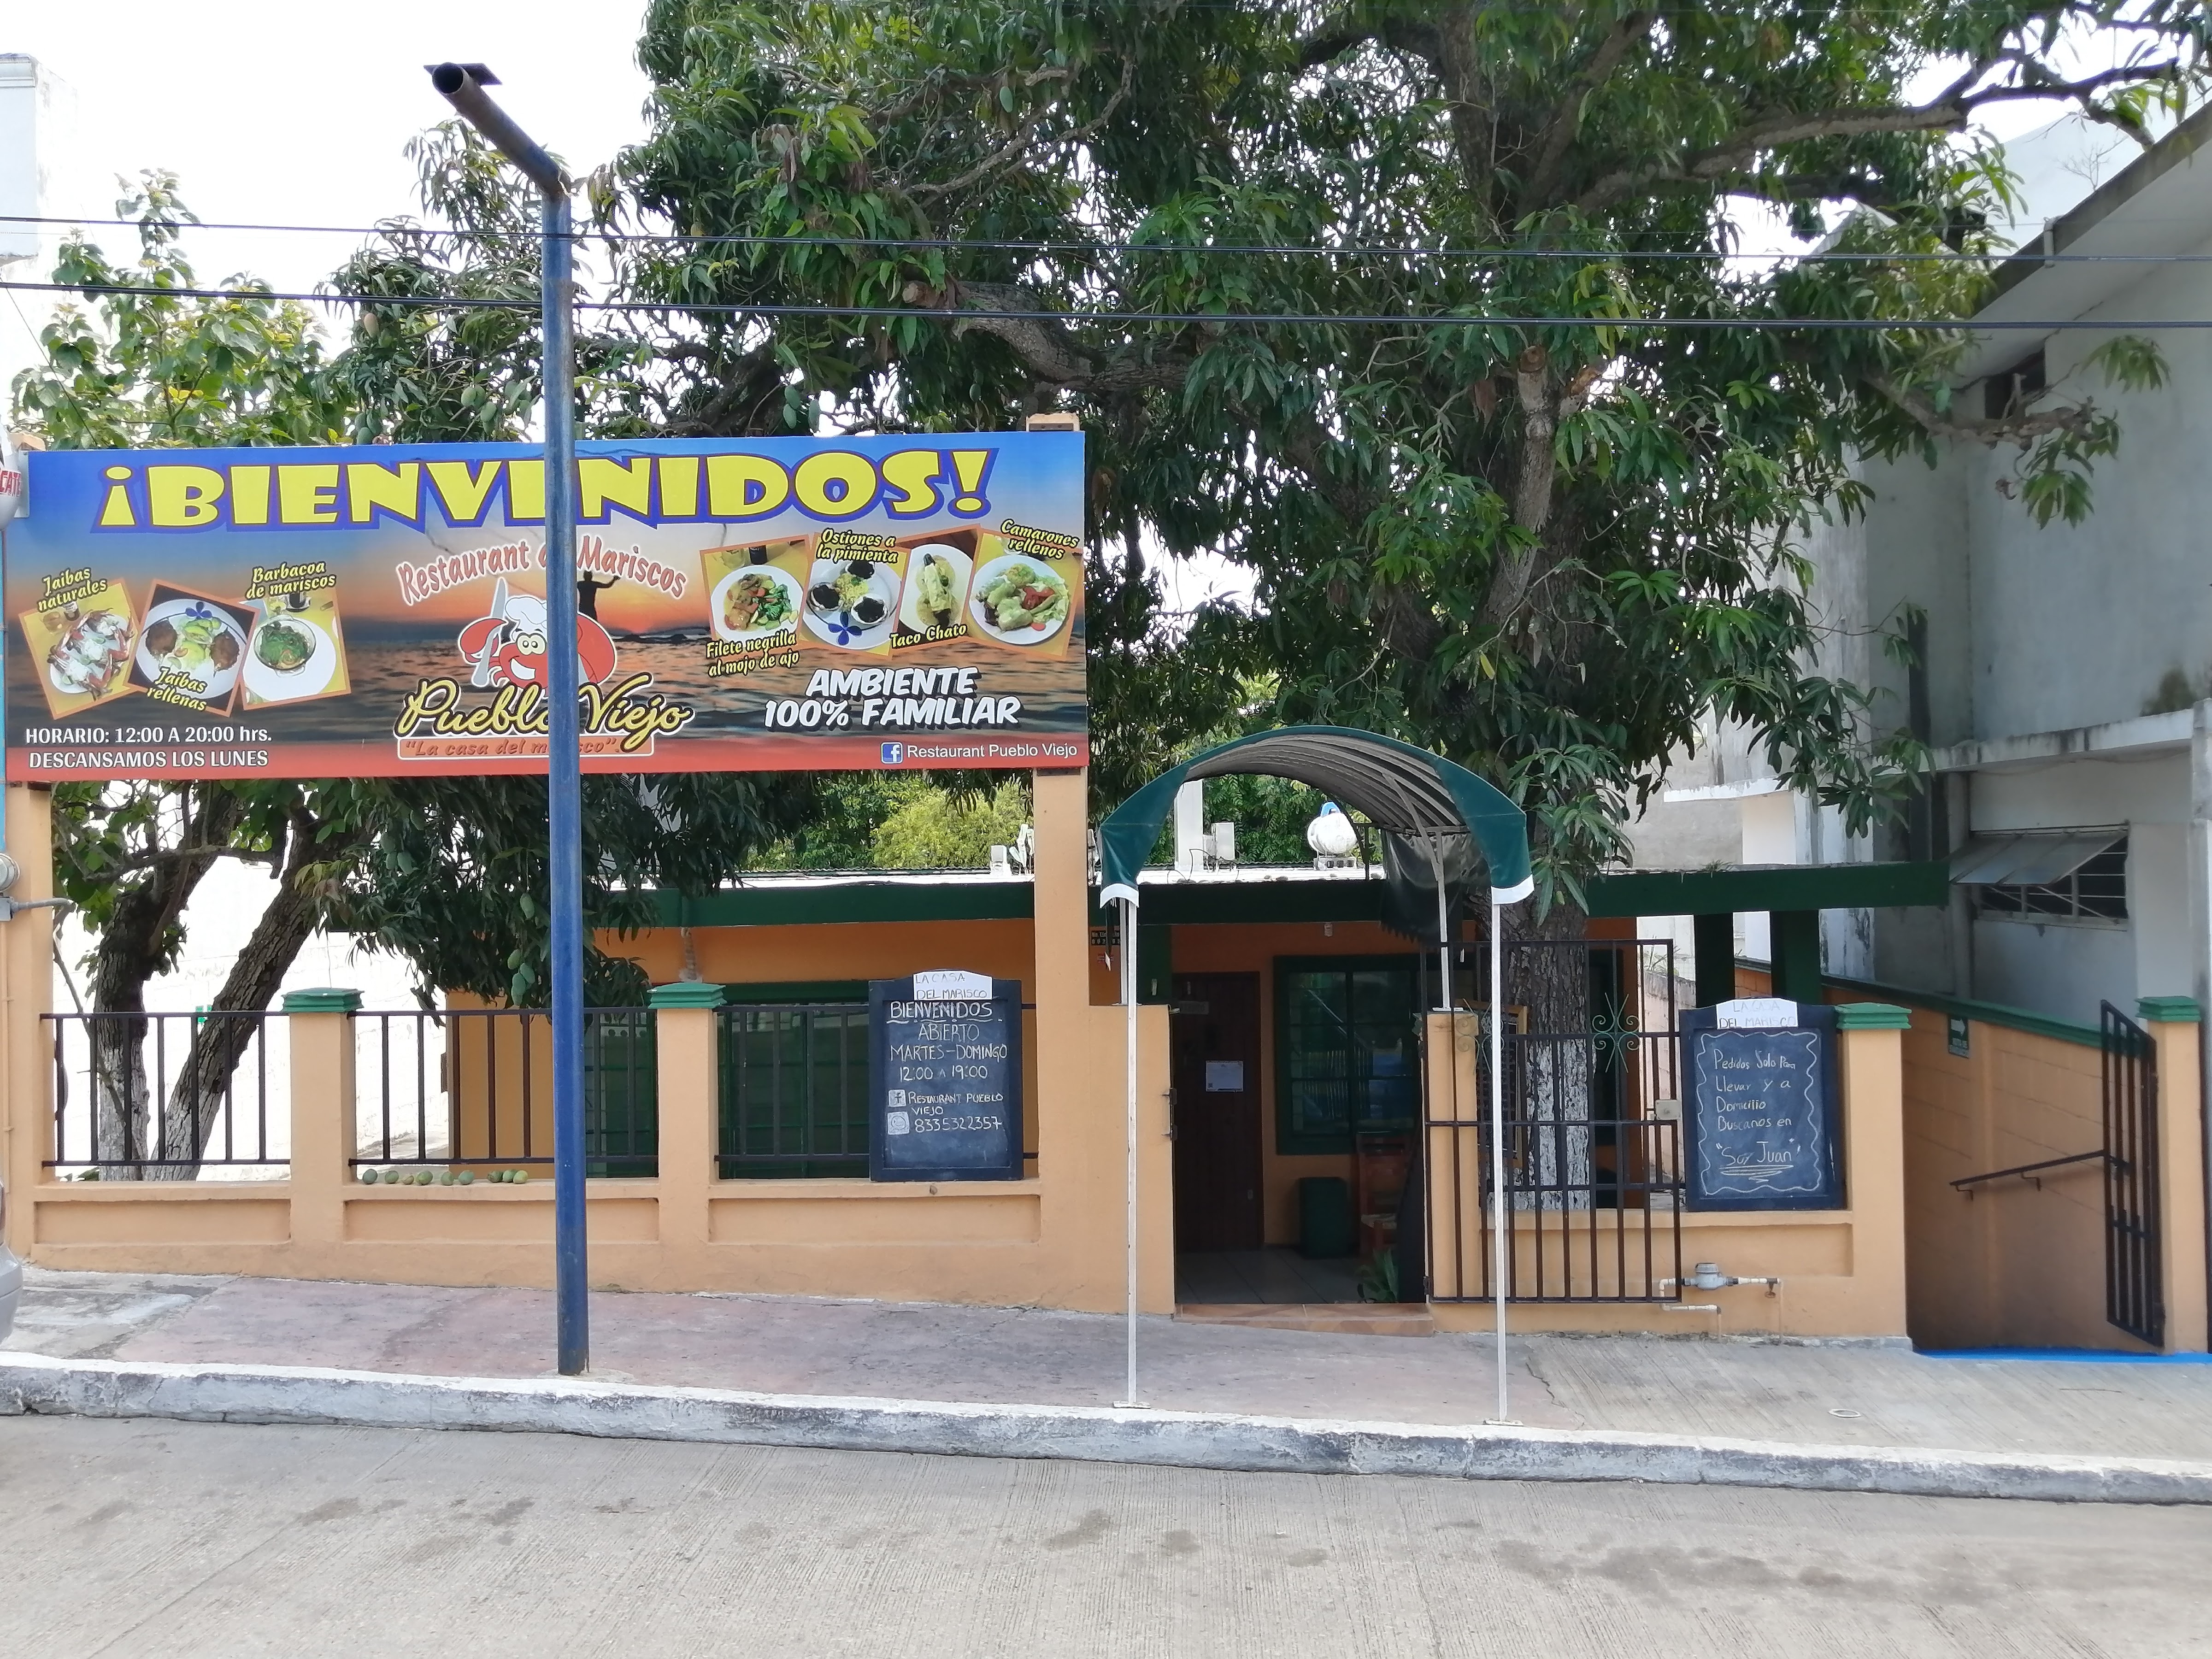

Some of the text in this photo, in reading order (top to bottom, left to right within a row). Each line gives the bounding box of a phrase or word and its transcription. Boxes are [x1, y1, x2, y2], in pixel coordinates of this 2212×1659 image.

[822, 529, 896, 547] Ostiones a
[1001, 519, 1079, 548] Camarones
[817, 544, 899, 564] la pimienta
[1008, 537, 1064, 560] rellenos
[253, 561, 325, 583] Barbacoa
[397, 541, 529, 604] Restaurant
[577, 536, 686, 598] Mariscos
[43, 568, 91, 596] Jaibas
[247, 574, 335, 599] de mariscos
[38, 579, 107, 612] naturales
[706, 629, 796, 659] Filete negrilla
[890, 624, 966, 648] Taco Chato
[709, 647, 800, 677] al mojo de ajo
[155, 668, 207, 693] Jaibas
[805, 667, 979, 698] AMBIENTE
[147, 686, 207, 711] rellenas
[578, 672, 695, 753] Viejo
[764, 696, 1022, 729] 100% FAMILIAR
[25, 725, 272, 745] HORARIO: 12:00 A 20:00 hrs.
[445, 742, 488, 756] casa
[495, 739, 525, 754] del
[907, 744, 985, 758] Restaurant
[989, 743, 1038, 757] Pueblo
[1043, 742, 1078, 761] Viejo
[29, 750, 269, 769] DESCANSAMOS LOS LUNES
[915, 972, 965, 984] LA CASA
[917, 989, 988, 1000] DEL MARISCO
[890, 1000, 993, 1019] BIENVENIDOS
[1719, 1017, 1796, 1029] DEL MARISCO
[1713, 1048, 1750, 1070] Pedidos
[1754, 1049, 1776, 1069] Solo
[900, 1066, 934, 1082] 12:00
[951, 1065, 988, 1080] 19:00
[1715, 1075, 1751, 1092] Llevar
[1780, 1080, 1791, 1088] a
[966, 1092, 1004, 1103] PUEBLO
[912, 1106, 944, 1116] VIEJO
[914, 1115, 1003, 1133] 8335322357
[1718, 1115, 1792, 1132] Buscanos en
